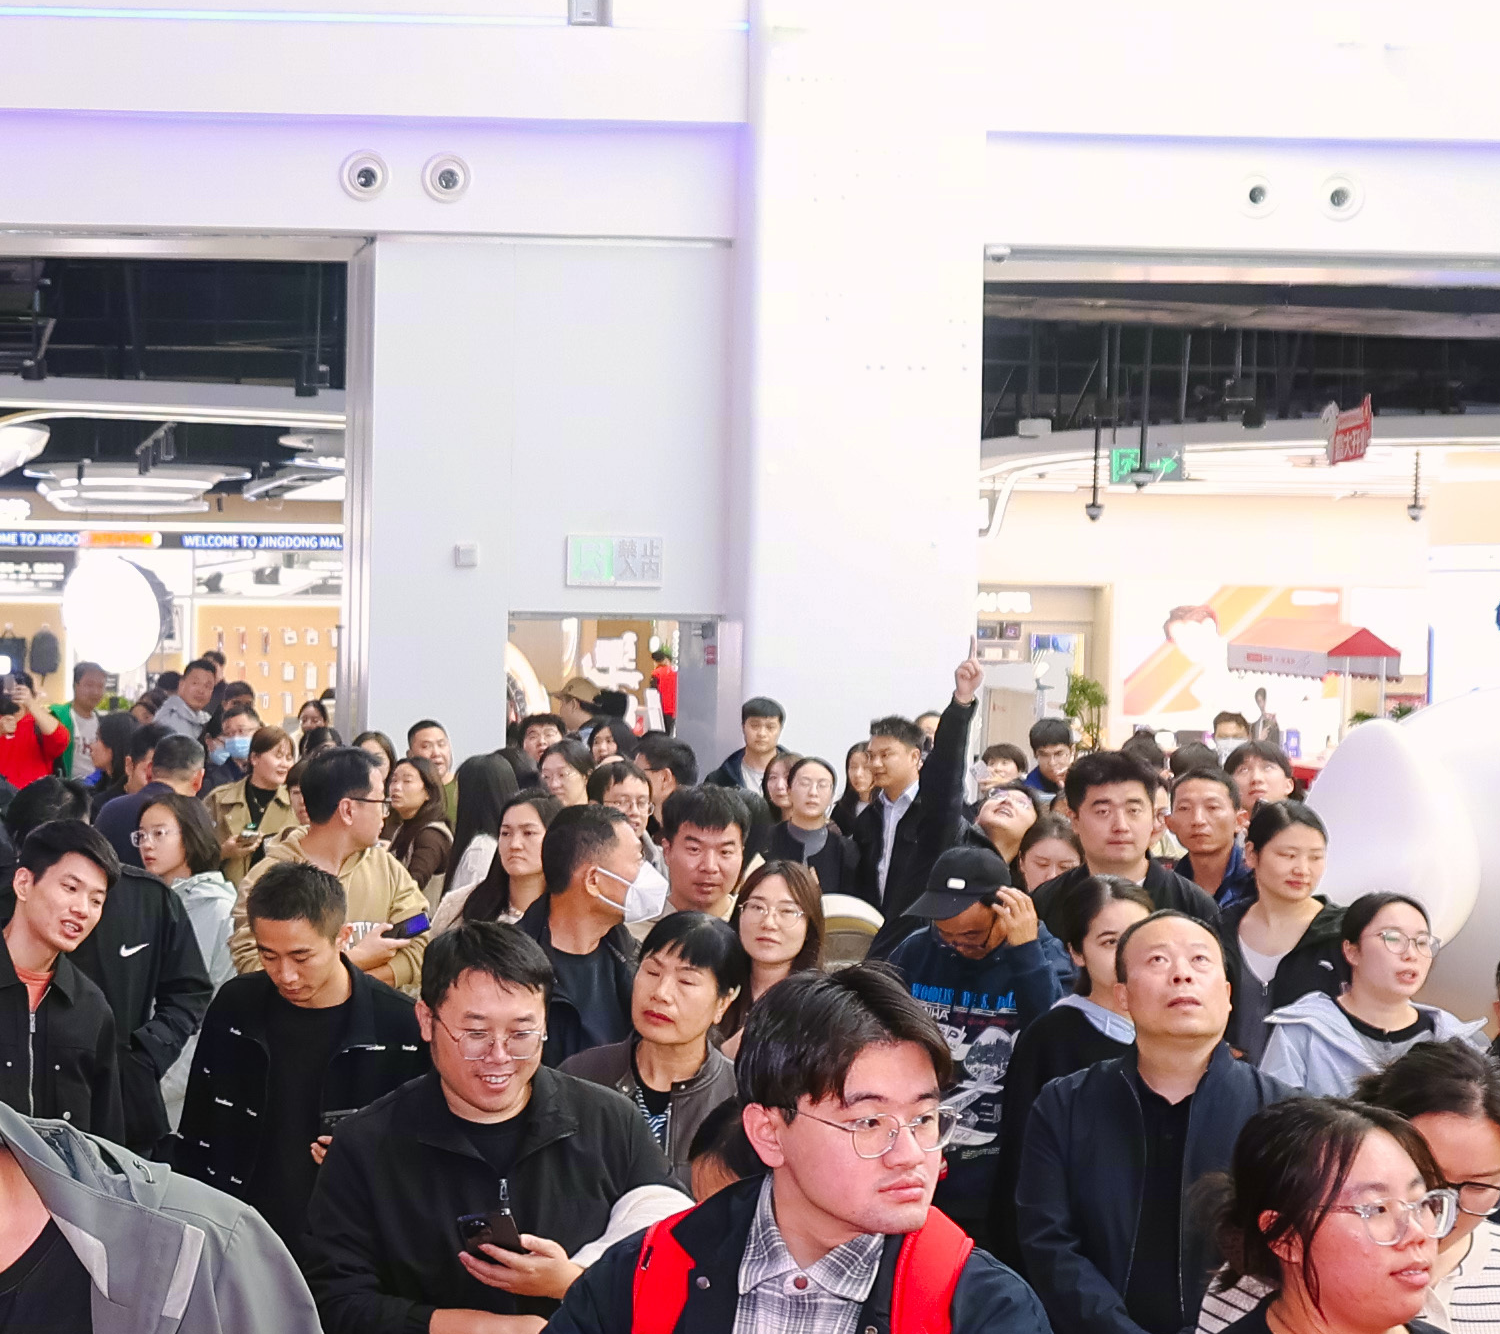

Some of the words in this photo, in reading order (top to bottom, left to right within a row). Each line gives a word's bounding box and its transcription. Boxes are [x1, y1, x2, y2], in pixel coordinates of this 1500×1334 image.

[19, 533, 36, 546] TO
[38, 533, 80, 547] JINGDO
[184, 534, 239, 548] WELCOME
[241, 535, 258, 548] TO
[259, 536, 318, 549] JINGDONG
[320, 537, 343, 549] MAL
[619, 539, 659, 558] 禁止
[619, 557, 659, 579] 入内
